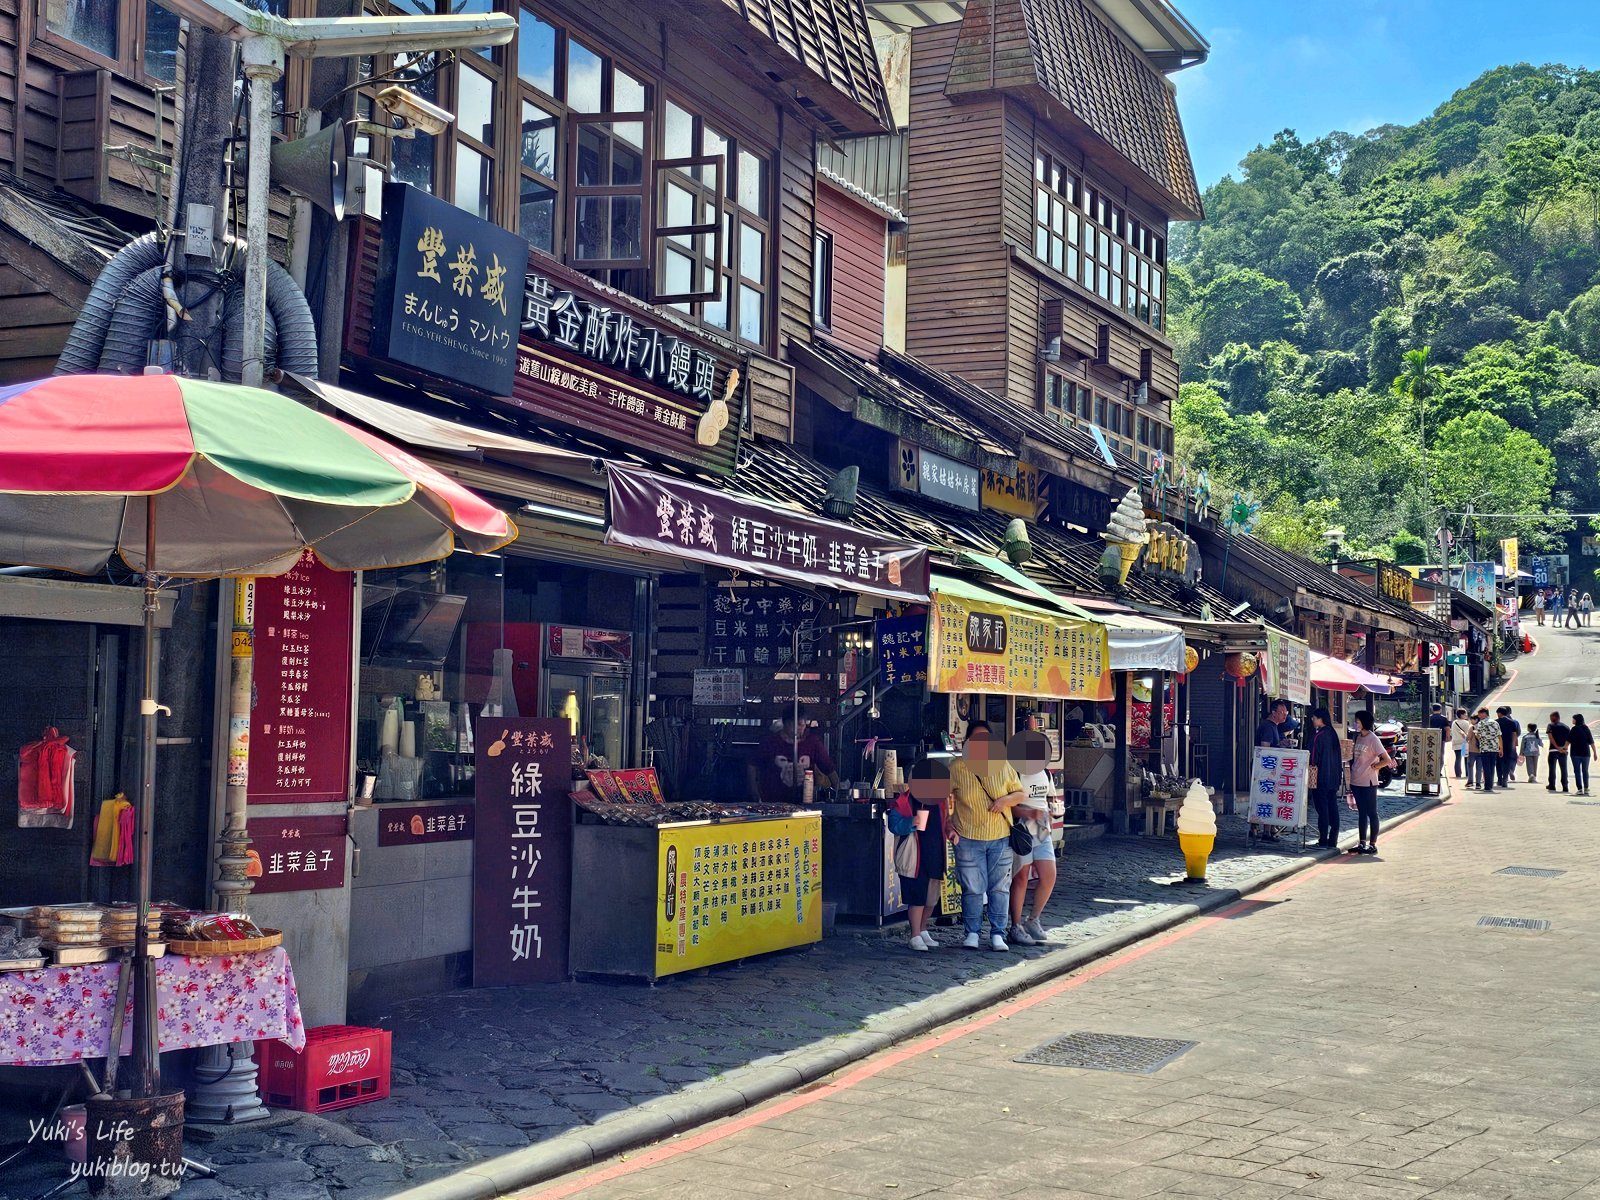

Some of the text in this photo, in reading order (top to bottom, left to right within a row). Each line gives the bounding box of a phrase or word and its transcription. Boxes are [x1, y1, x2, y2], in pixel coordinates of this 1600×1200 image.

[404, 293, 510, 350] まんじゅう マントウ
[521, 272, 718, 399] 黃金酥炸小饅頭
[922, 461, 977, 497] 魏家姑姑私房菜
[280, 695, 301, 704] 冬瓜茶
[1425, 735, 1436, 777] 客家菜
[275, 778, 312, 788] 巧克力可可
[1257, 756, 1278, 818] 客家菜
[426, 814, 467, 833] 韭菜盒子
[269, 849, 334, 875] 韭菜盒子
[510, 761, 543, 962] 綠豆沙牛奶
